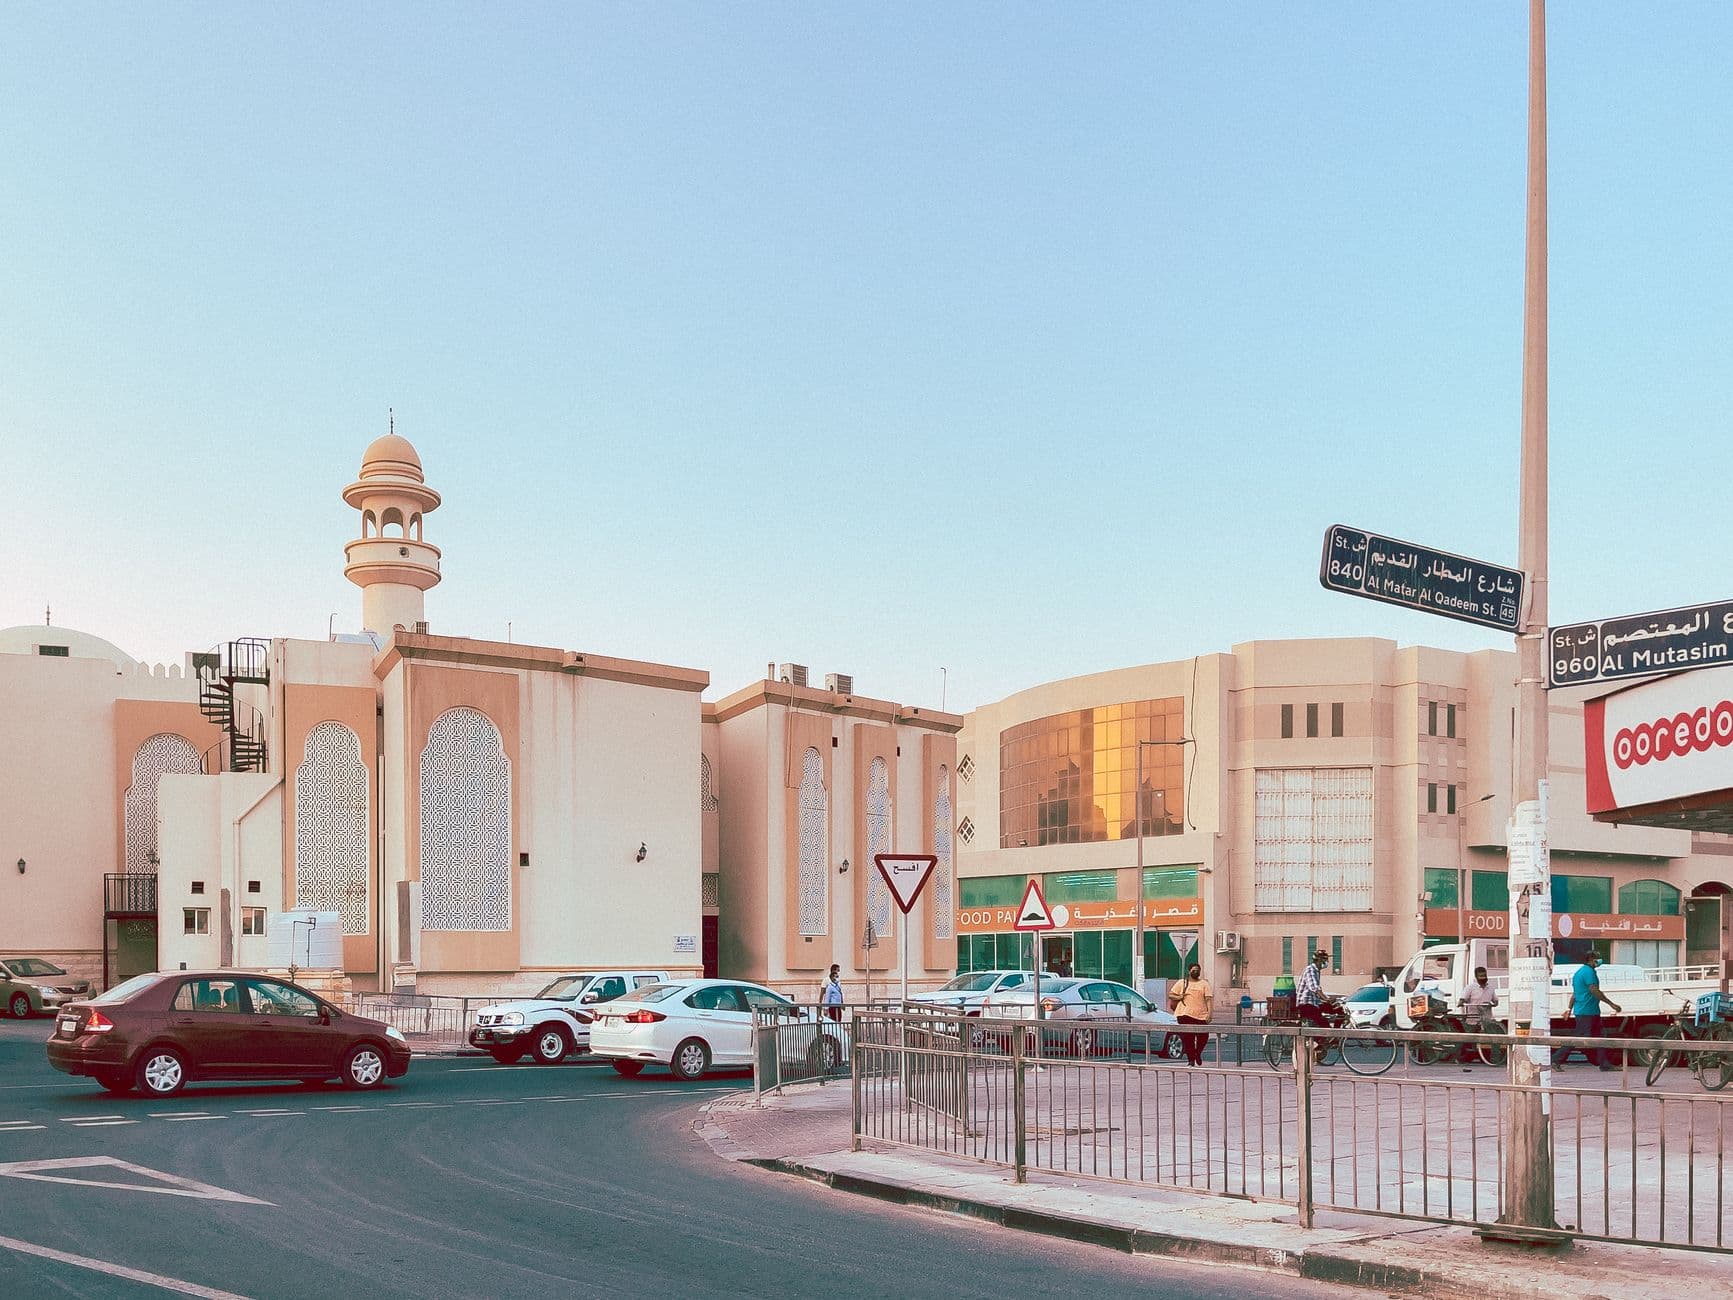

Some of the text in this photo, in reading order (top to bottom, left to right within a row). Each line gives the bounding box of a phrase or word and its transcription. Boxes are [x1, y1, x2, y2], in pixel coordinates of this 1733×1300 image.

[1335, 535, 1350, 550] St.
[1352, 538, 1366, 552] ش
[1330, 559, 1363, 580] 840
[1371, 551, 1515, 594] شارع المطار القديم
[1367, 575, 1497, 617] Al Matar Al Qadeem St.
[1501, 607, 1514, 619] 45
[1577, 628, 1597, 645] ش
[1603, 610, 1710, 652] المعتصم
[1555, 634, 1575, 648] St.
[1555, 655, 1597, 675] 960
[1601, 642, 1728, 673] Al Mutasim
[1151, 903, 1199, 919] قصر
[1468, 915, 1504, 930] FOOD
